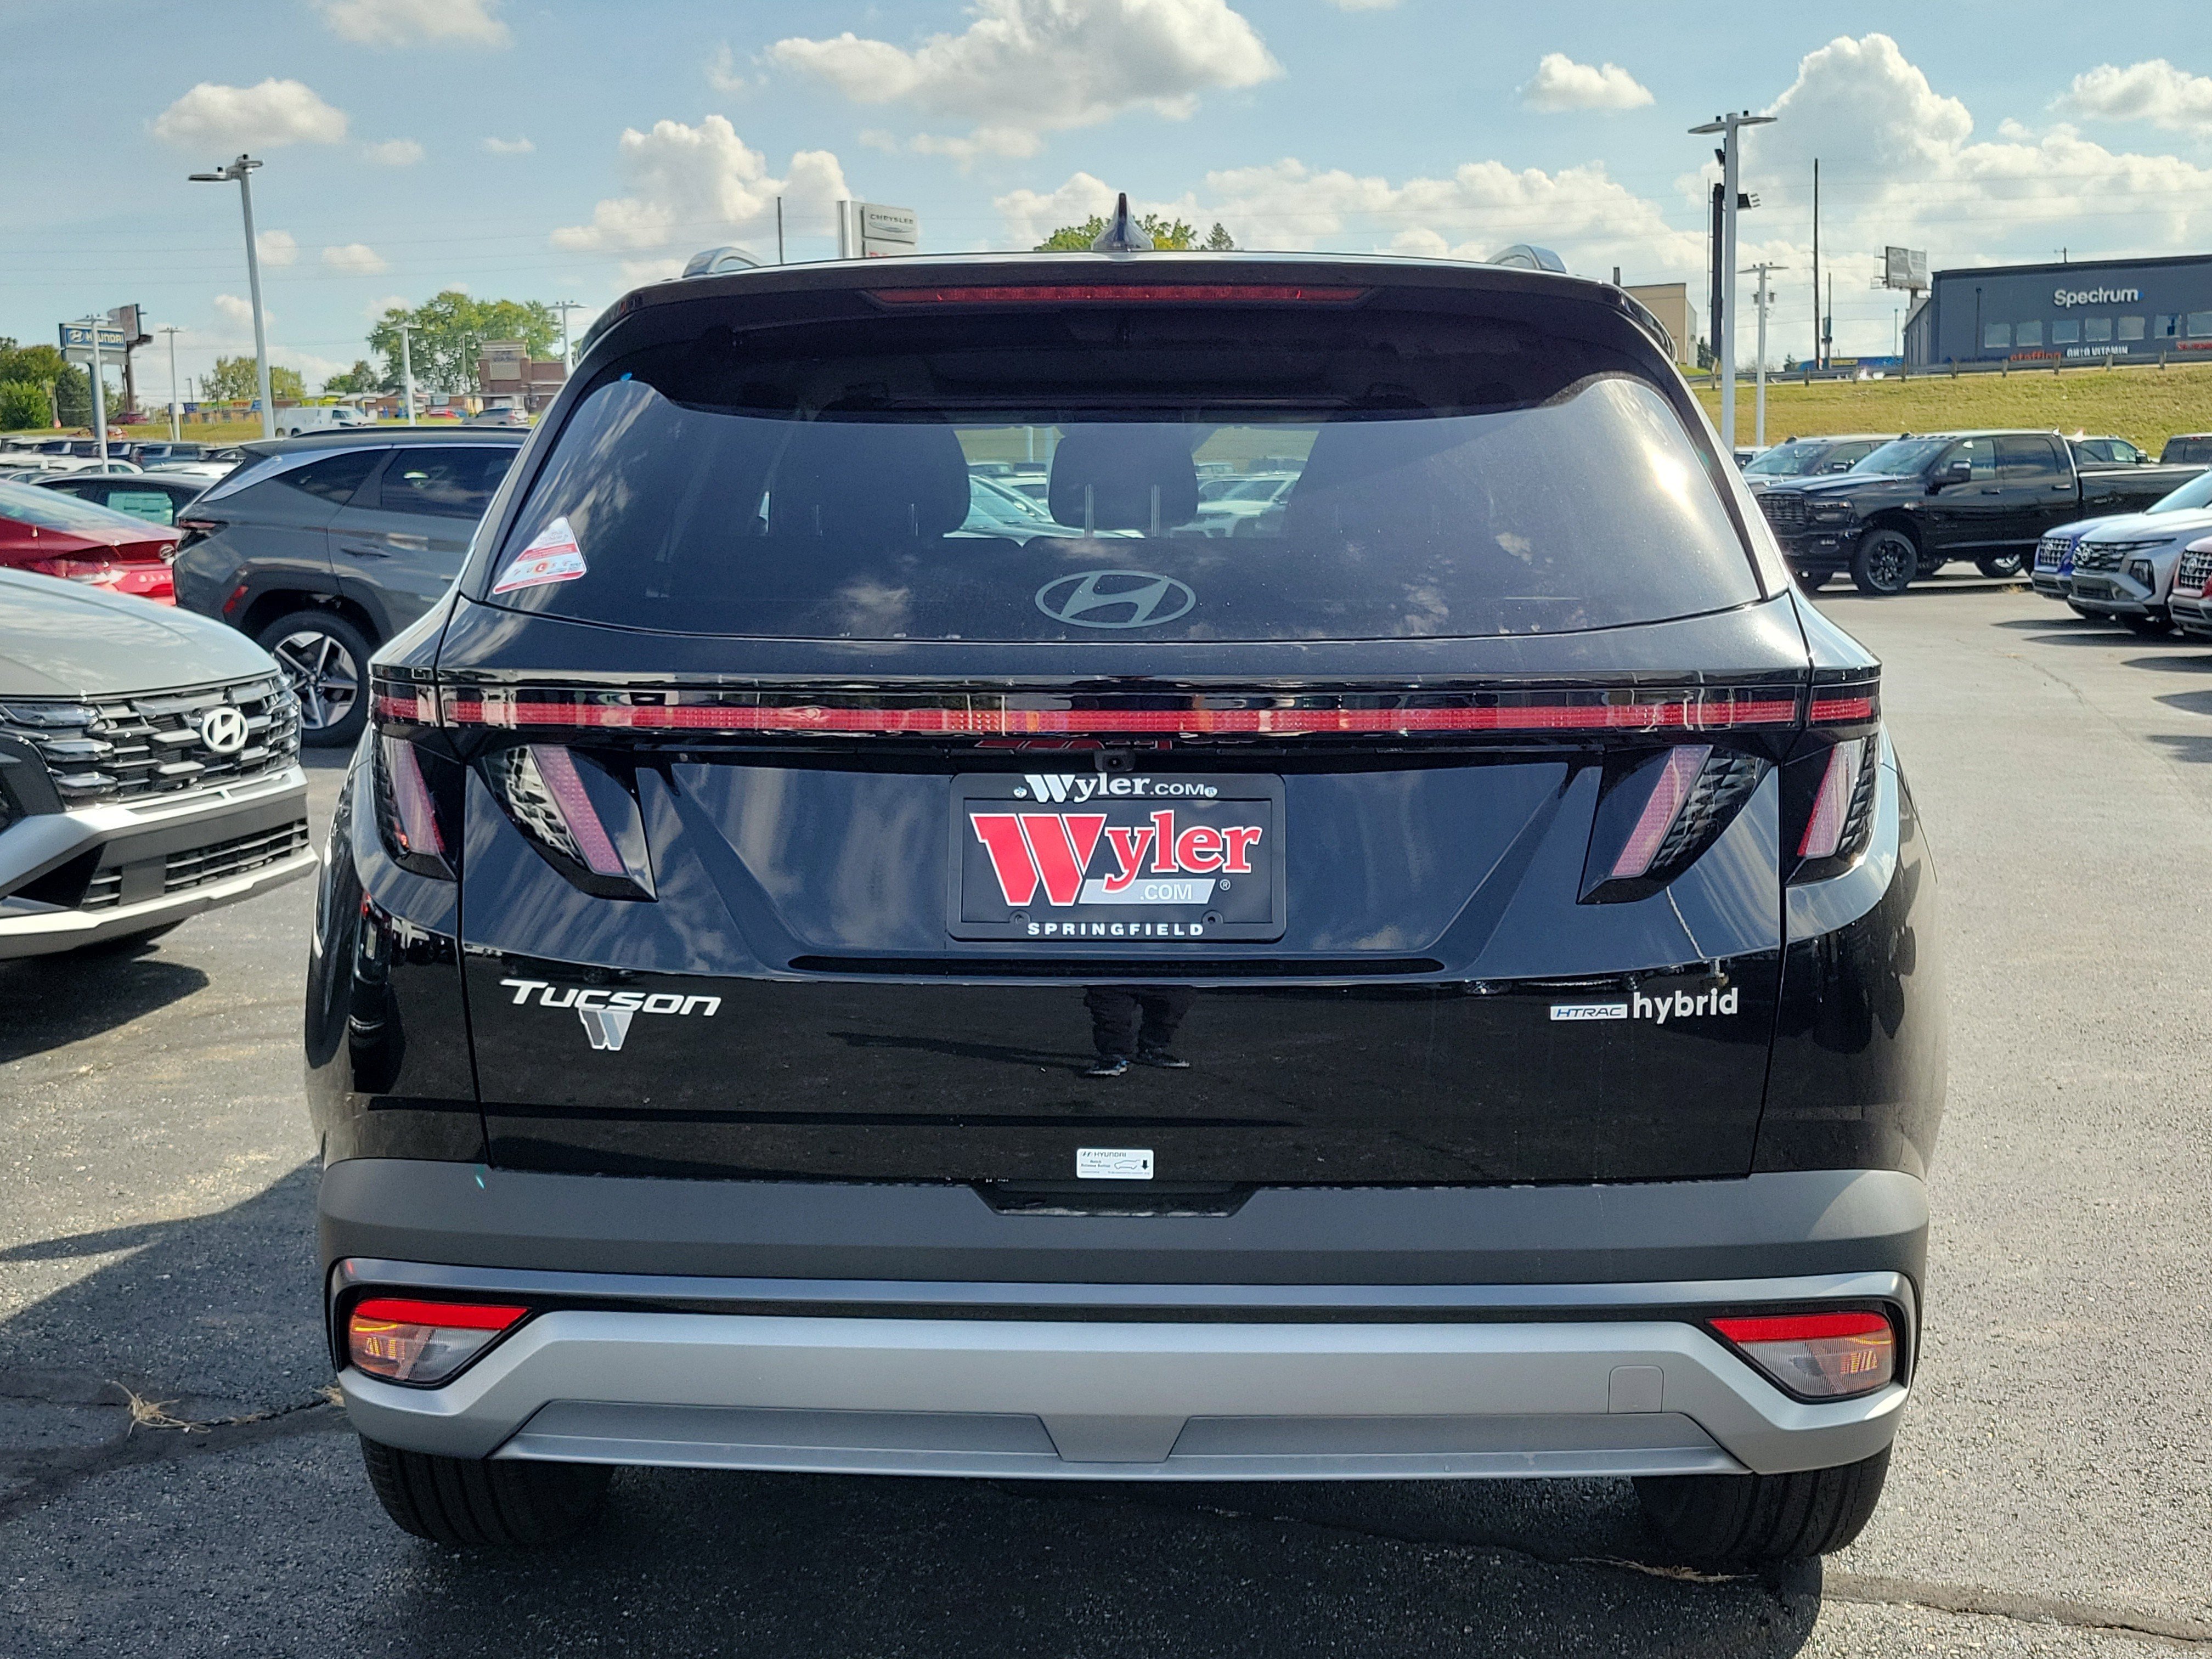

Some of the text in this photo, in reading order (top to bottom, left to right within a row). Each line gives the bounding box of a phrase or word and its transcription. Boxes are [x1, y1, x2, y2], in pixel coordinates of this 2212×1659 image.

[870, 214, 914, 224] CHRYSLER
[2054, 286, 2138, 308] Spectrum
[85, 331, 123, 343] HUNDAI
[969, 809, 1263, 907] Wyler
[1027, 922, 1204, 936] SPRINGFIELD
[1556, 987, 1739, 1025] HTRAC hybrid
